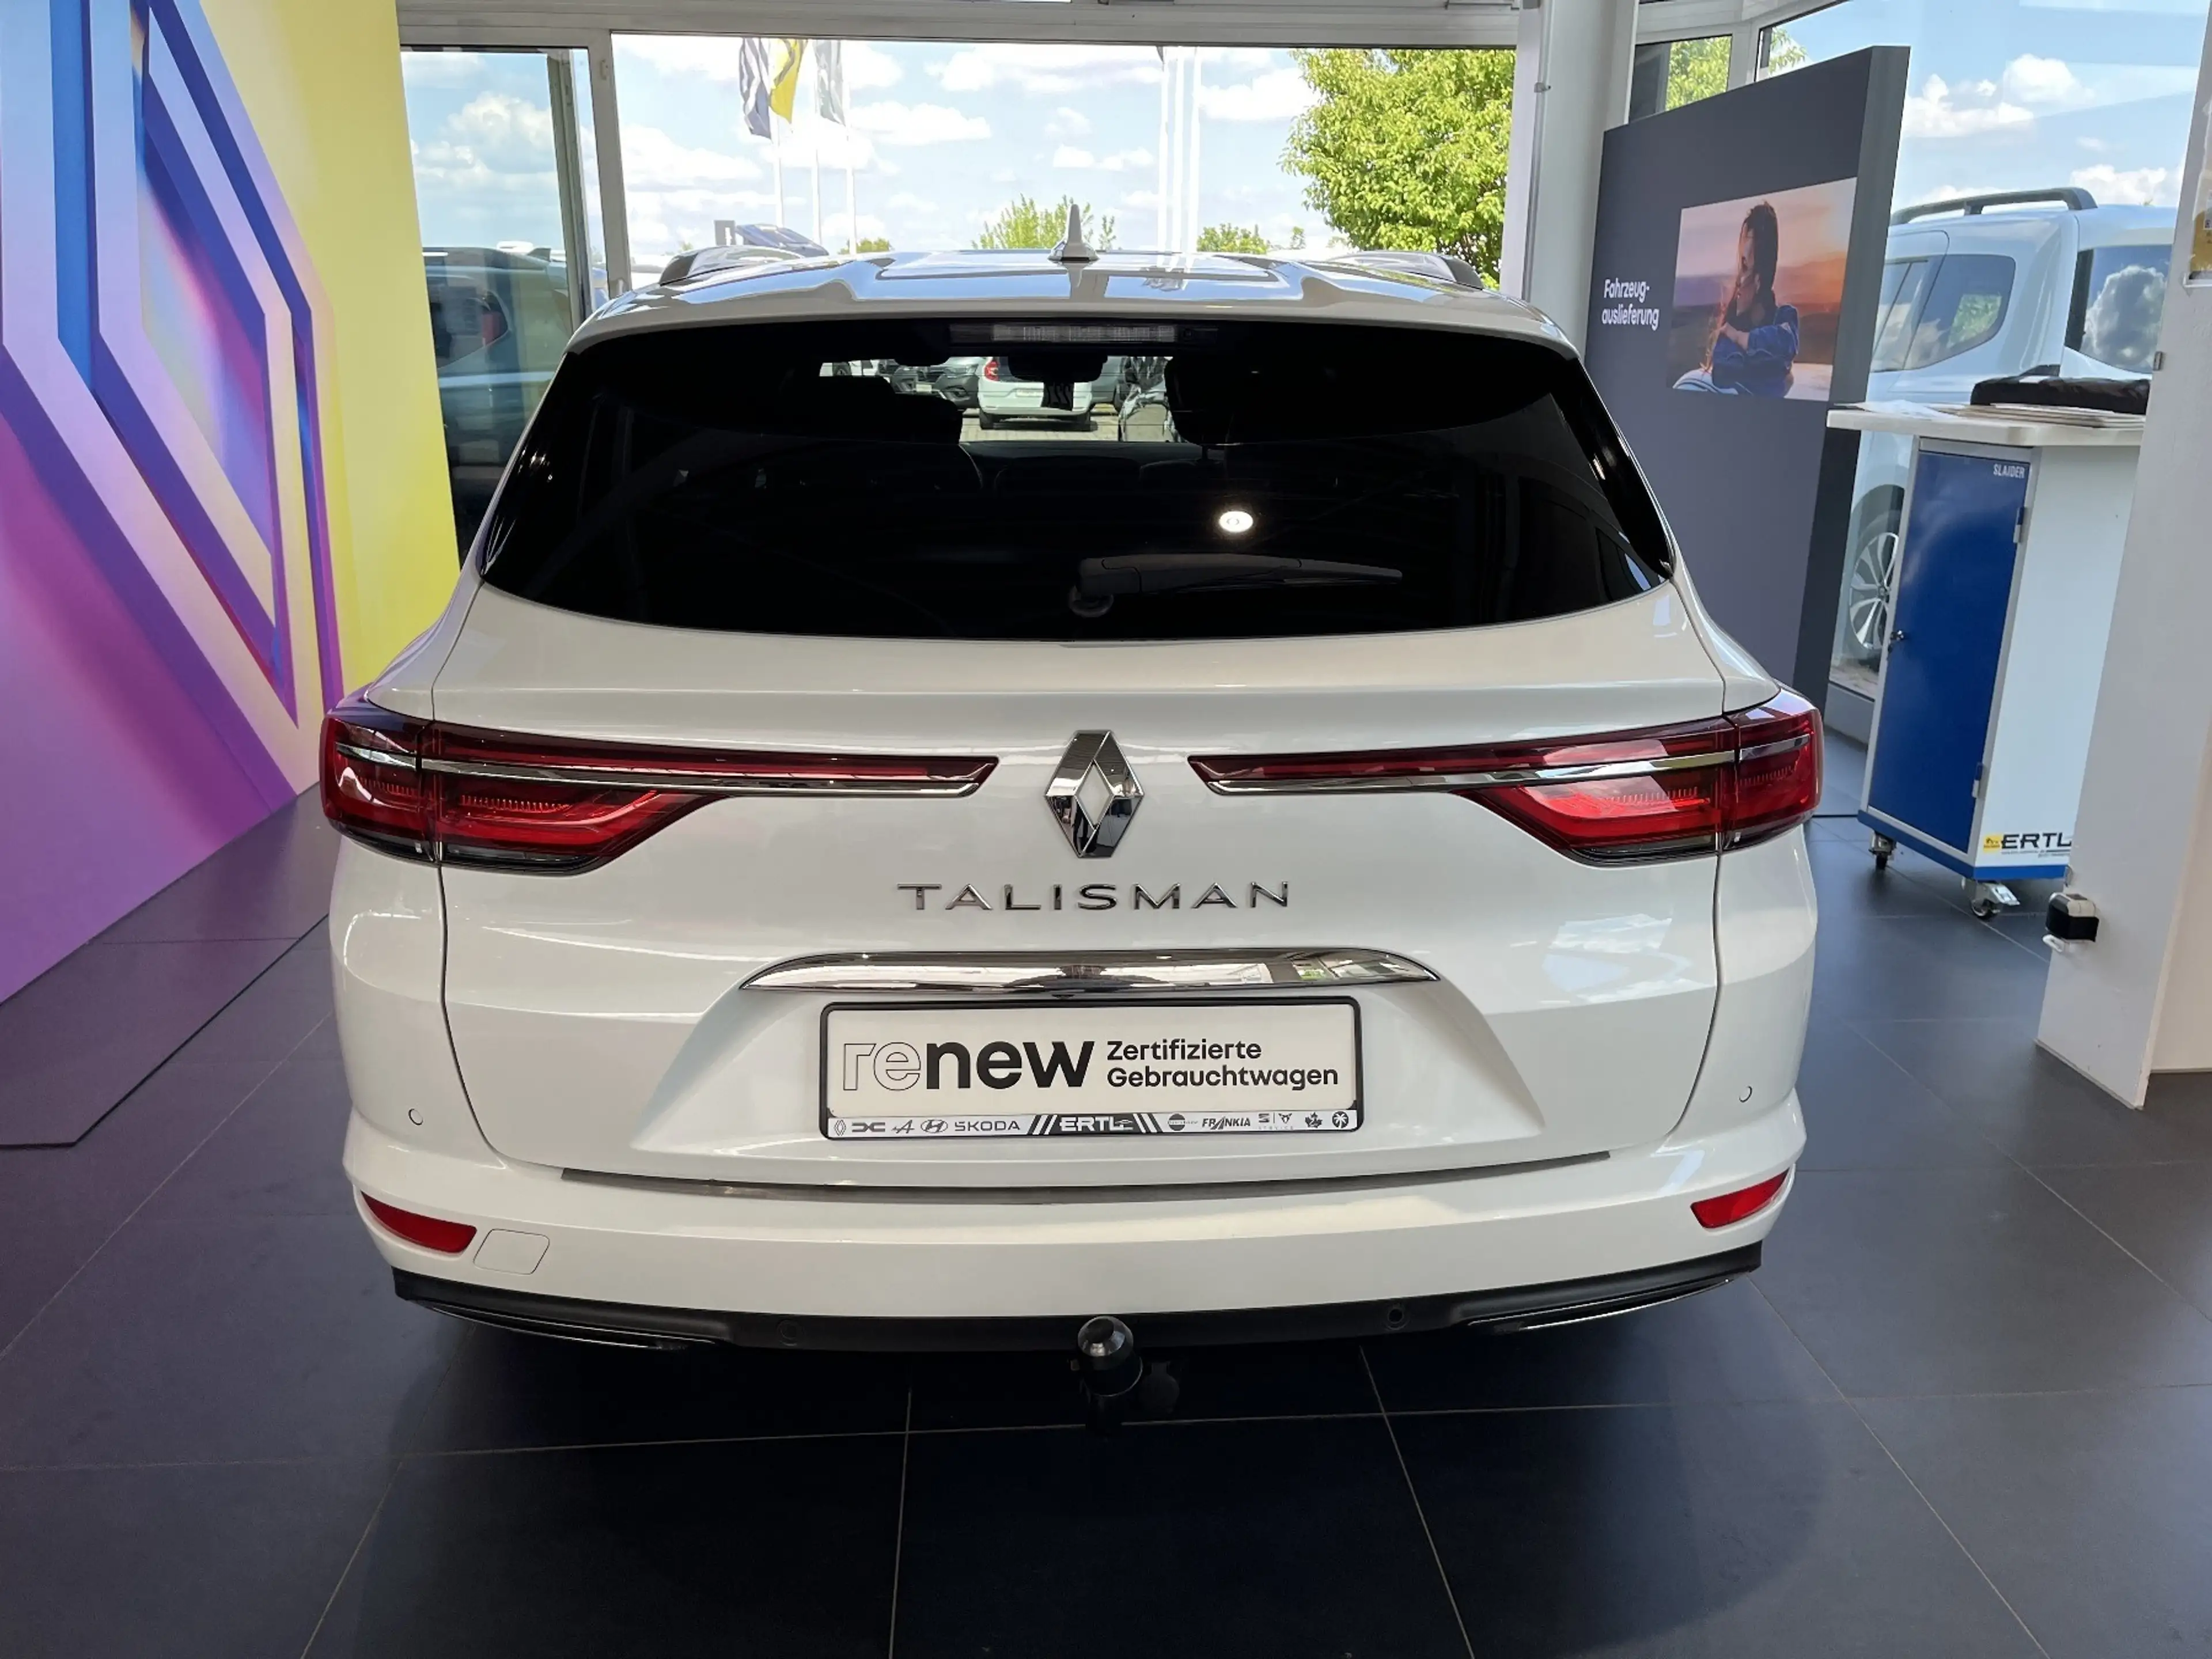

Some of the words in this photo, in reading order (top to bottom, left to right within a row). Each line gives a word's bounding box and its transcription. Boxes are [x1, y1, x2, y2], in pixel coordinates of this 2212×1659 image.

[1603, 277, 1650, 303] Fahrzeug-
[1601, 303, 1659, 331] auslieferung
[2001, 832, 2072, 849] ERTL
[897, 881, 1289, 910] TALISMAN
[1107, 1039, 1262, 1060] Zertifizierte
[843, 1040, 1095, 1091] renew
[1107, 1065, 1338, 1091] Gebrauchtwagen
[1059, 1116, 1134, 1132] ERTL
[1202, 1116, 1251, 1130] FRANKIA
